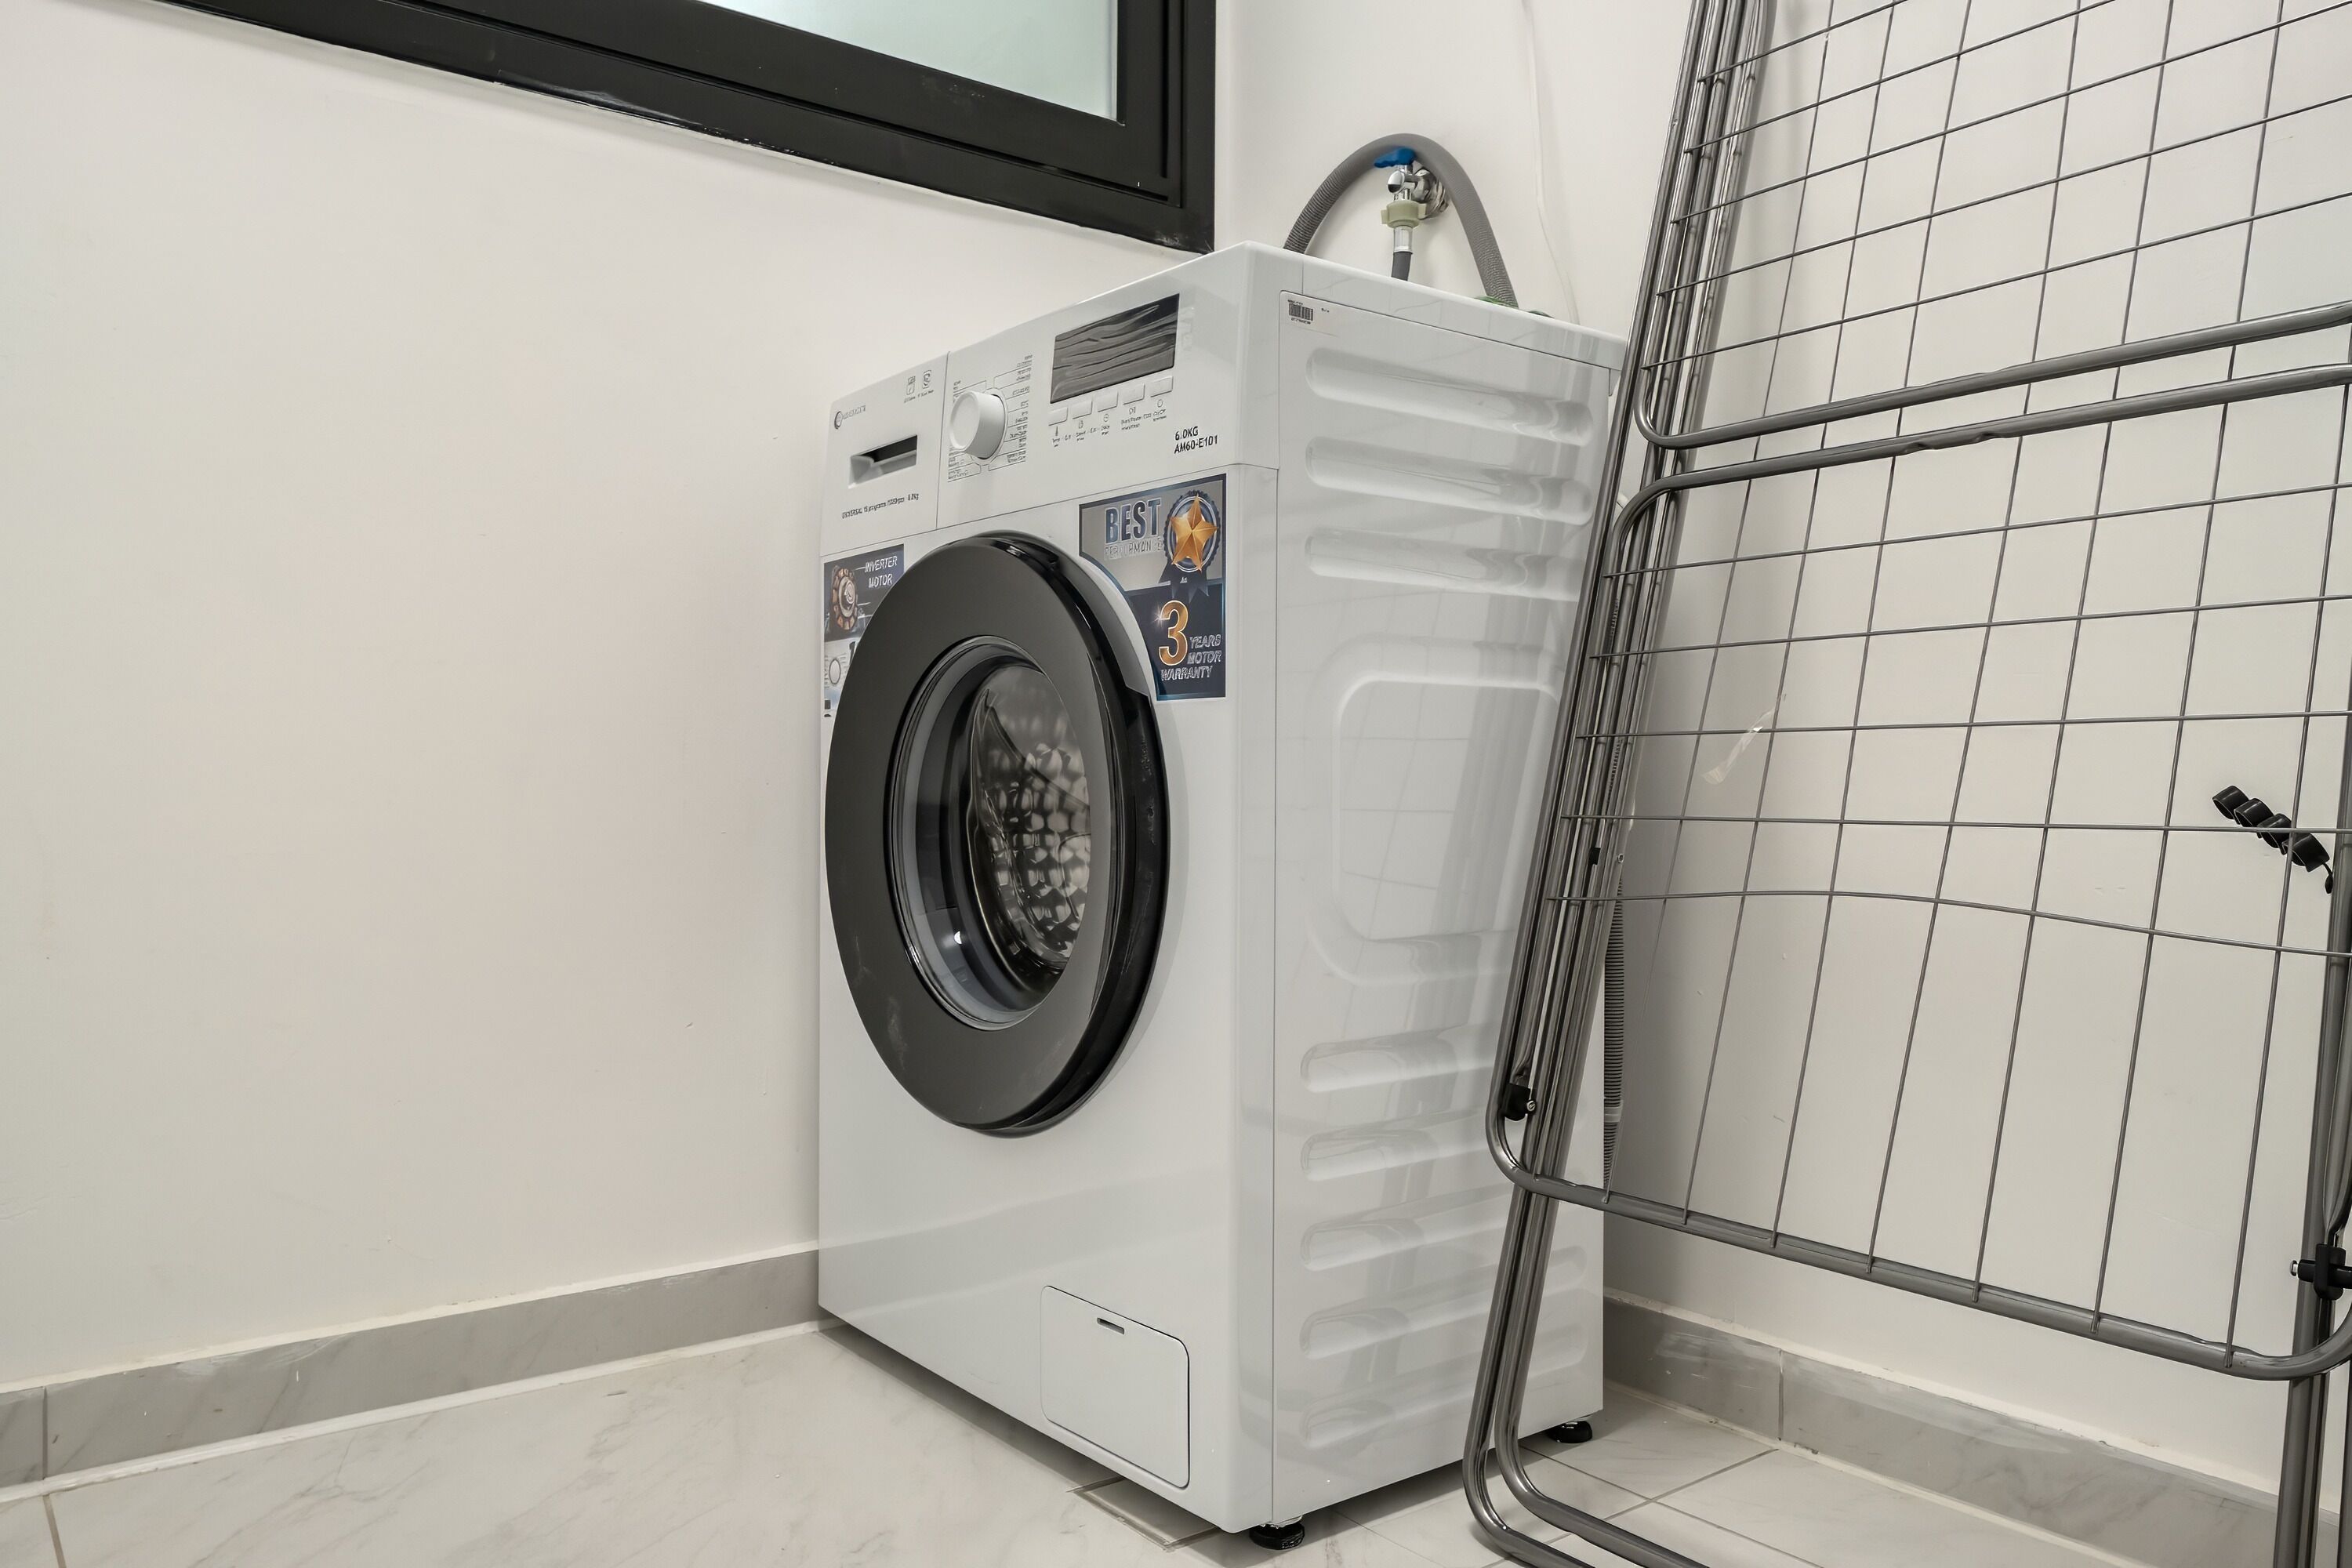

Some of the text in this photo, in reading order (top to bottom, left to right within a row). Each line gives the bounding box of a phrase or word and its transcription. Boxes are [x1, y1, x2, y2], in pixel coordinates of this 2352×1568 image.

[1175, 426, 1198, 441] 6.0KG
[1174, 434, 1218, 454] AM60-E101
[1105, 497, 1162, 545] BEST
[1104, 536, 1163, 559] PERORMANE
[865, 556, 898, 572] INVERTER
[869, 573, 893, 588] MOTOR
[1159, 600, 1189, 666] 3
[1189, 634, 1221, 648] YEARS
[1187, 650, 1222, 665] MOTOR
[1160, 666, 1214, 681] WARRANTY
